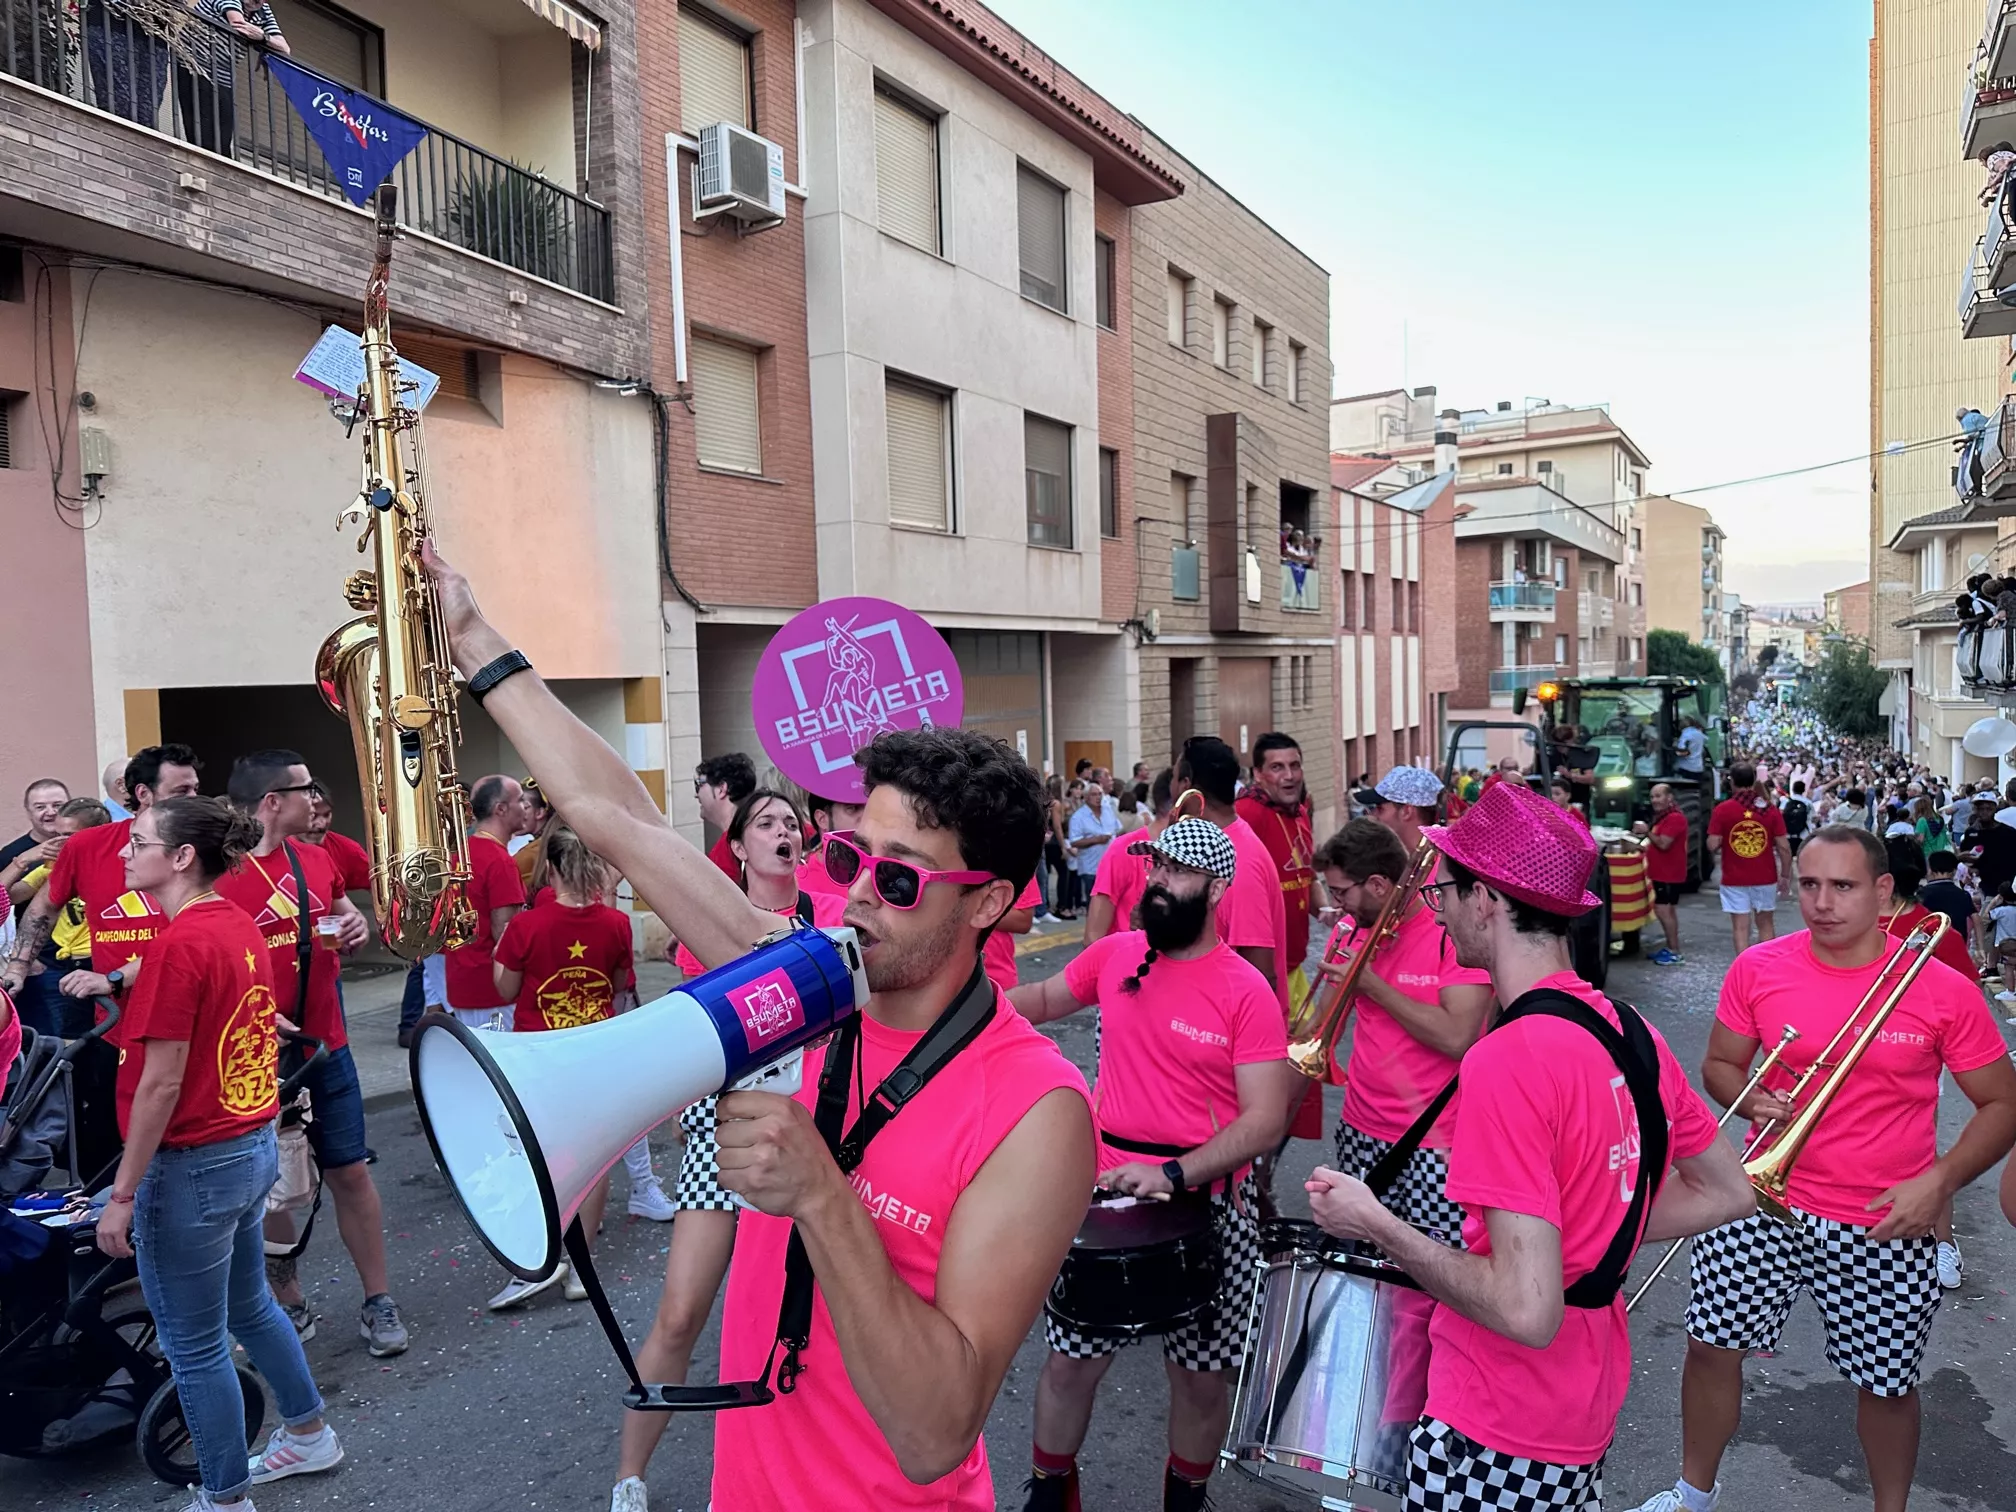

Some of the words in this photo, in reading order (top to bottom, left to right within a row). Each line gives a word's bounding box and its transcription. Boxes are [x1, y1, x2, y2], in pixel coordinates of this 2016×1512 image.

[775, 669, 949, 745] BSUMETA
[95, 929, 137, 943] CAMPEONAS
[137, 927, 153, 941] DEL
[264, 930, 297, 949] EONAS
[746, 996, 797, 1030] BSUMETA
[1170, 1019, 1228, 1047] BSUMETA
[1854, 1025, 1925, 1046] BMETA
